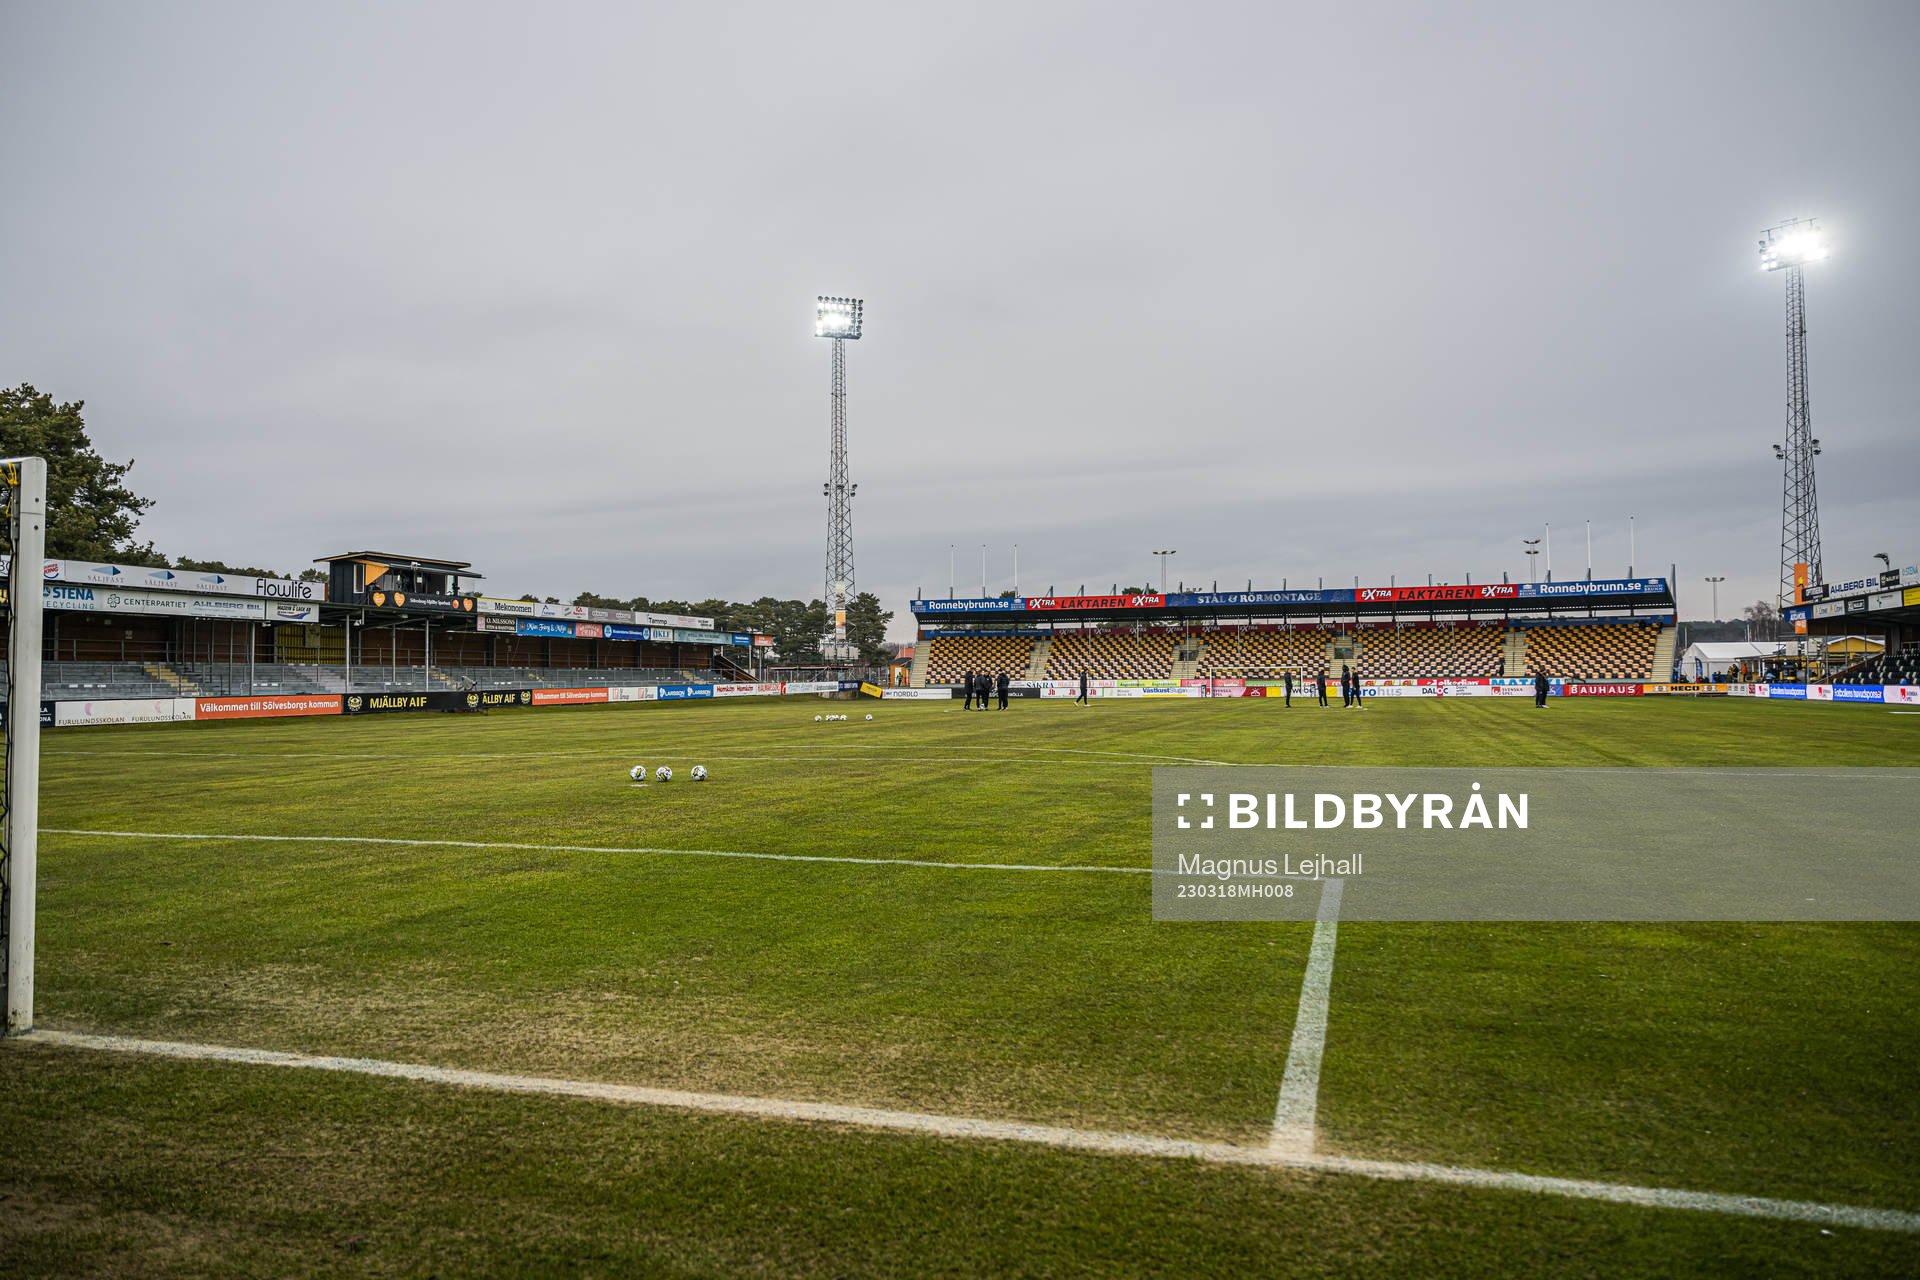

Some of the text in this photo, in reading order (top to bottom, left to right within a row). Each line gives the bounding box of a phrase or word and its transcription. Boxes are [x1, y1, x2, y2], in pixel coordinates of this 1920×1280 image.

[256, 578, 312, 599] Flowlife
[1481, 585, 1514, 597] EXTRA
[1540, 581, 1641, 595] Ronnebybrunn.se
[1830, 580, 1865, 594] AHLBERG
[1866, 578, 1879, 587] BIL
[53, 586, 95, 601] STENA
[1198, 592, 1322, 604] STÅL & RÖRMONTAGE
[1361, 588, 1392, 600] EXTRA
[46, 602, 95, 610] ECYCLING
[124, 598, 186, 608] CENTERPARTIET
[193, 601, 244, 609] AHLBERG
[929, 601, 1008, 611] Ronnebybrunn.se
[1030, 598, 1056, 609] EXTRA
[1132, 595, 1160, 606] EXTRA
[495, 602, 532, 613] Mekonomen
[1570, 685, 1636, 694] BAUHAUS
[370, 696, 427, 708] MJÄLLBY AIF
[504, 694, 515, 703] AIF
[200, 699, 338, 712] Välkommen till Sölvesborgs kommun
[58, 717, 125, 725] FURULUNDSSKOLAN
